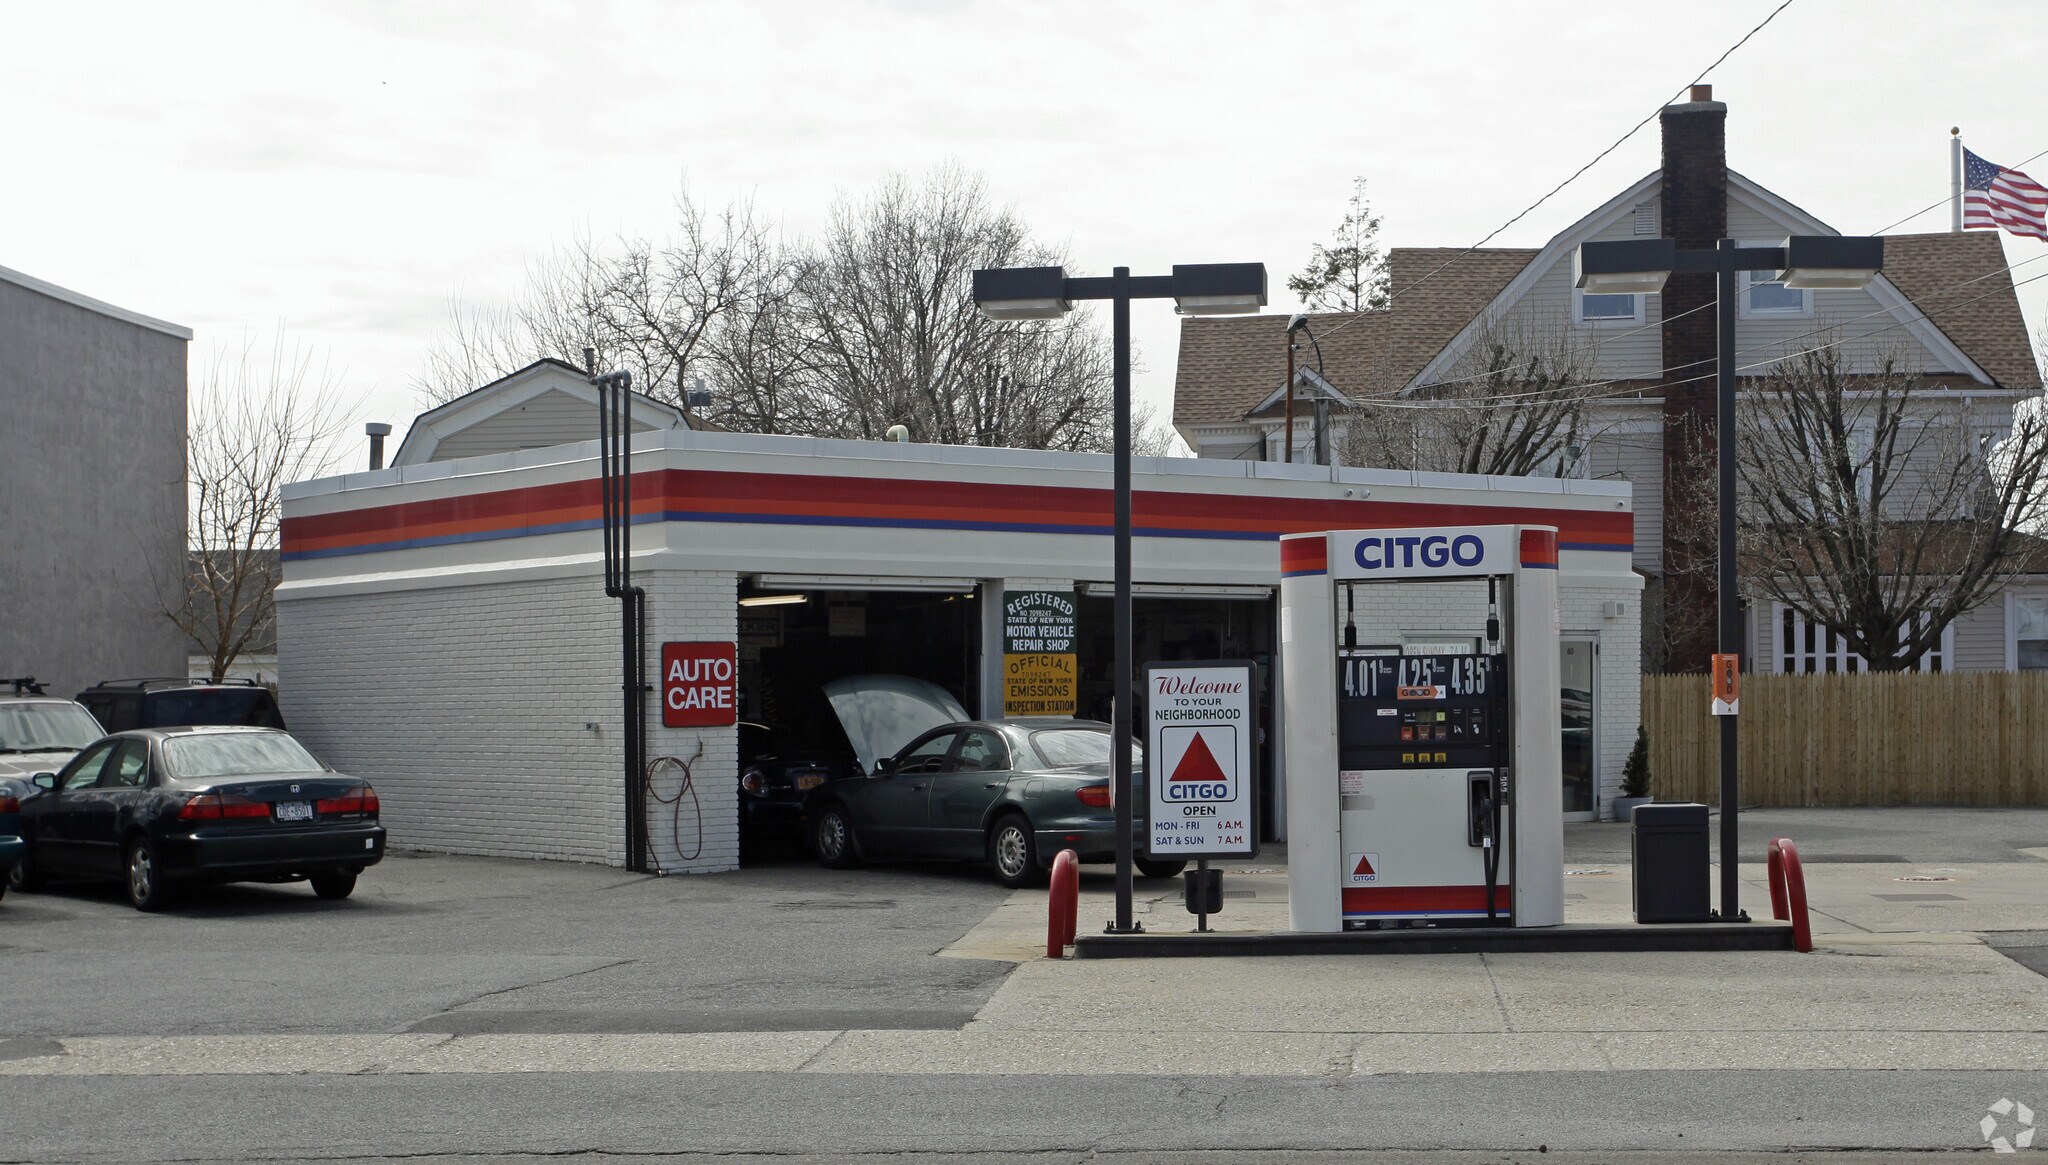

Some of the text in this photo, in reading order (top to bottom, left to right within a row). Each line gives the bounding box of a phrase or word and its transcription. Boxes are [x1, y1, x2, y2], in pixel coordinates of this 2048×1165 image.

[1354, 534, 1484, 569] CITGO
[1007, 592, 1073, 615] REGISTERED
[1007, 626, 1074, 637] MOTOR VEHICLE
[1013, 640, 1070, 650] REPAIR SHOP
[668, 658, 732, 681] AUTO
[1010, 656, 1070, 674] OFFICIAL
[1399, 658, 1432, 686] 425
[1345, 660, 1377, 696] 4.01
[1452, 657, 1485, 695] 4.35
[1011, 686, 1069, 697] EMISSIONS
[1154, 676, 1243, 695] Welcome
[668, 686, 732, 710] CARE
[1006, 700, 1074, 712] INSPECTION STATION
[1155, 708, 1241, 720] NEIGHBORHOOD
[1169, 784, 1227, 799] CITGO
[1183, 806, 1216, 816] OPEN
[1155, 822, 1178, 830] MON
[1186, 821, 1200, 830] FRI
[1217, 821, 1222, 829] 6
[1225, 821, 1244, 829] A.M.
[1156, 836, 1244, 845] SAT & SUN 7 A.M.
